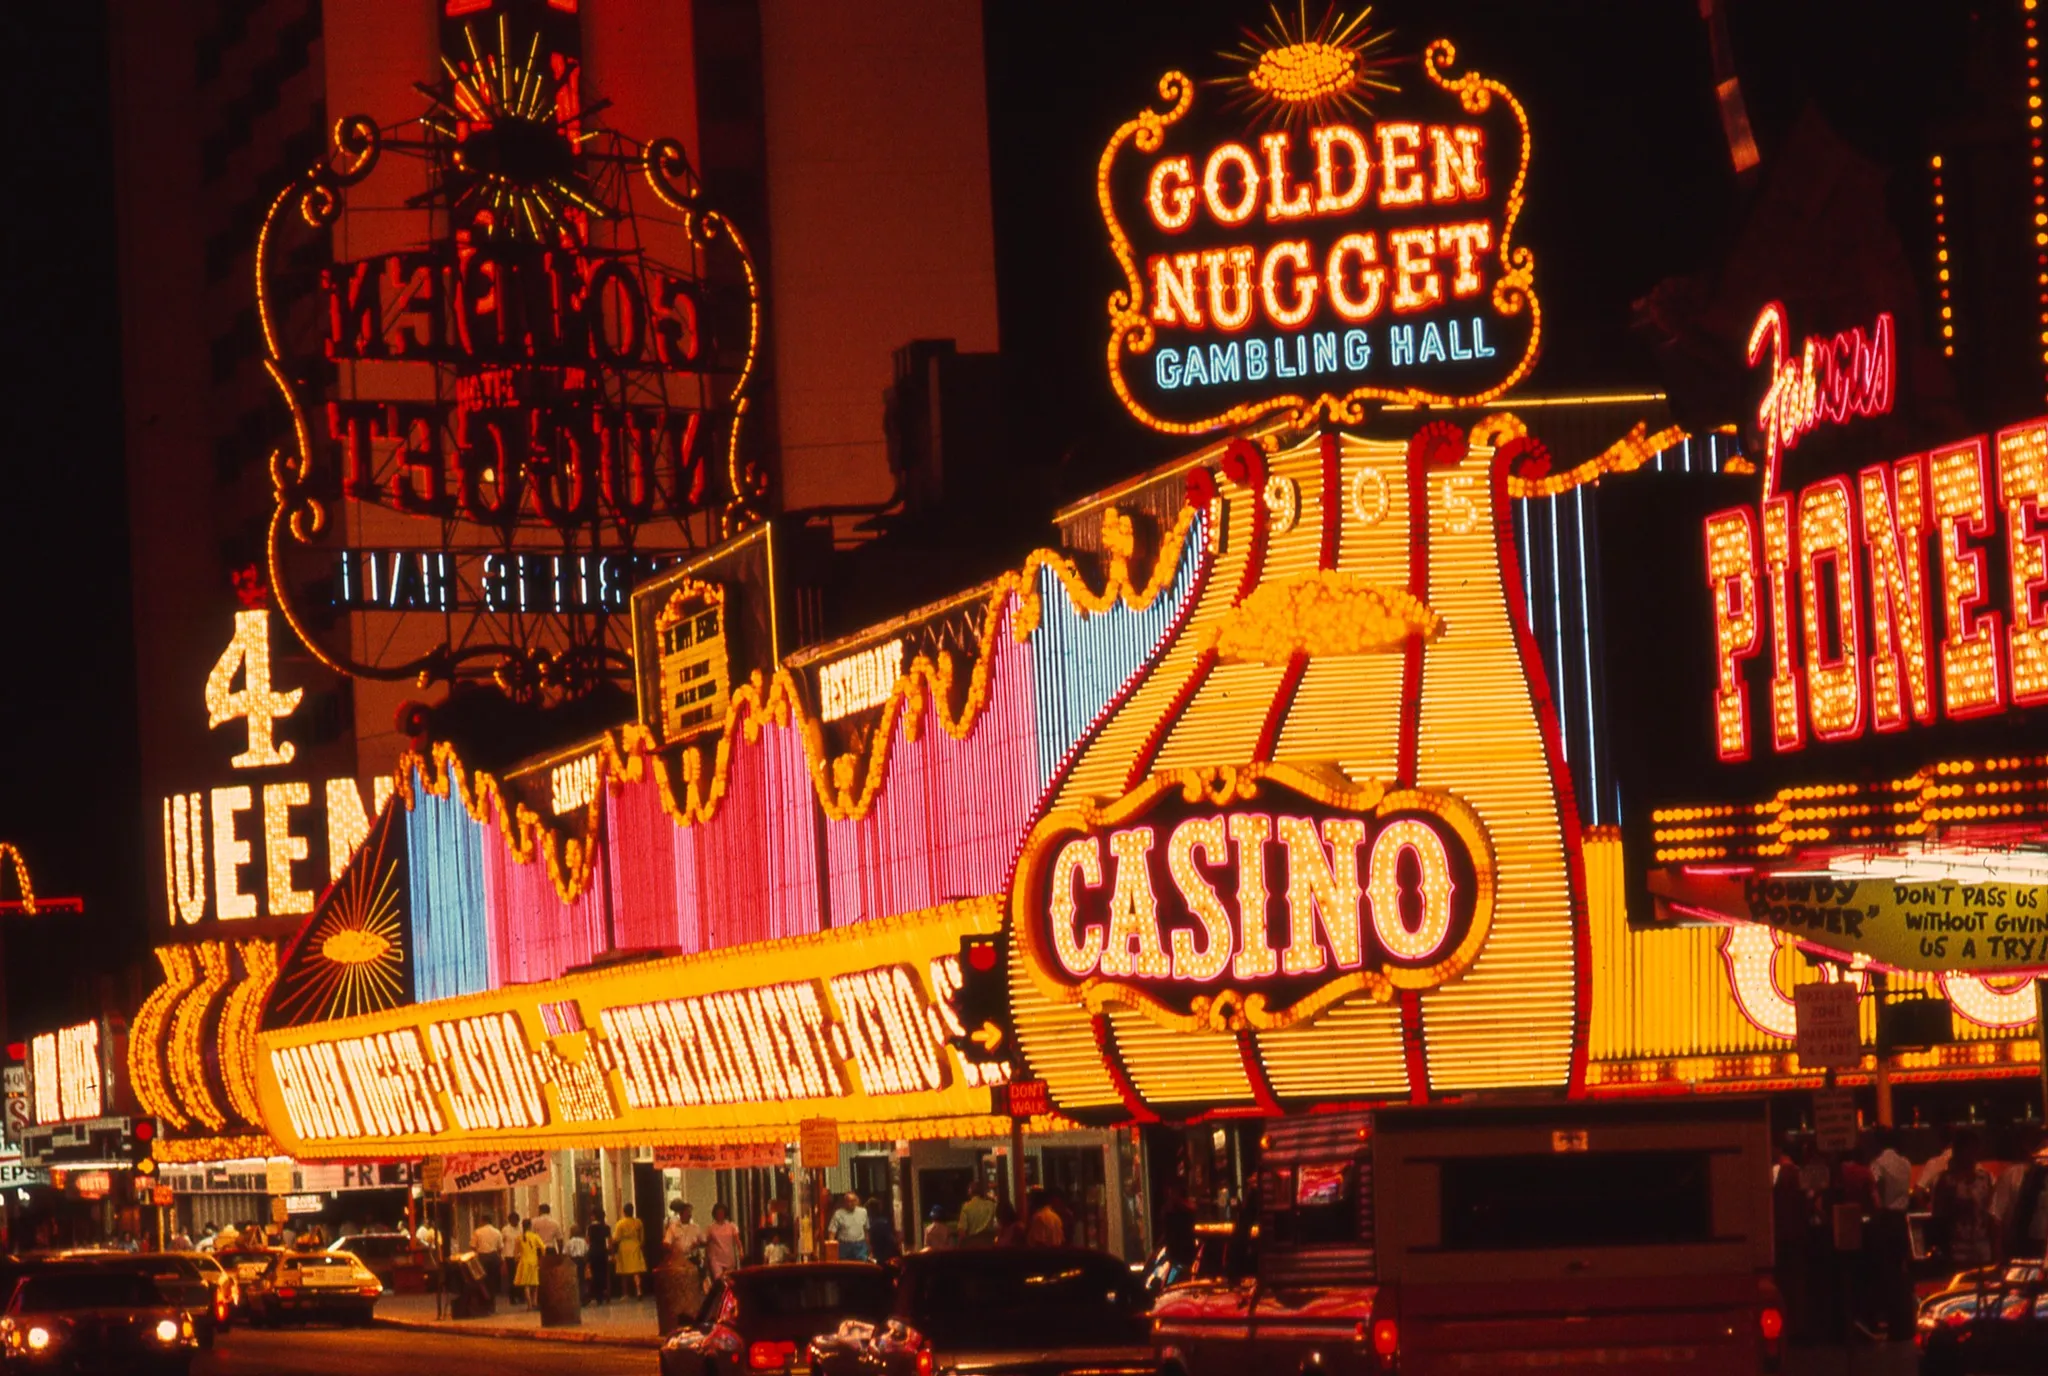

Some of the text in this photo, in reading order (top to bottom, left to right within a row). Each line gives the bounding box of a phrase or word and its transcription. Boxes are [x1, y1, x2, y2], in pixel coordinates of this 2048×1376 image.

[1149, 123, 1485, 230] GOLDEN
[1149, 221, 1491, 329] NUGGET
[1155, 317, 1496, 390] GAMBLING HALL
[205, 609, 303, 769] 4
[163, 775, 395, 926] UEEN
[1049, 813, 1455, 982] CASINO
[1893, 884, 2039, 909] DON'T PASS US
[1905, 911, 1989, 932] WITHOUT
[1919, 935, 2048, 963] US A TRY!
[271, 1042, 361, 1139] GOLDEN
[337, 1029, 443, 1136] NUGGET
[429, 1012, 545, 1130] CASINO
[829, 965, 943, 1096] KENO
[454, 1150, 545, 1190] mercedes
[503, 1158, 548, 1186] benz
